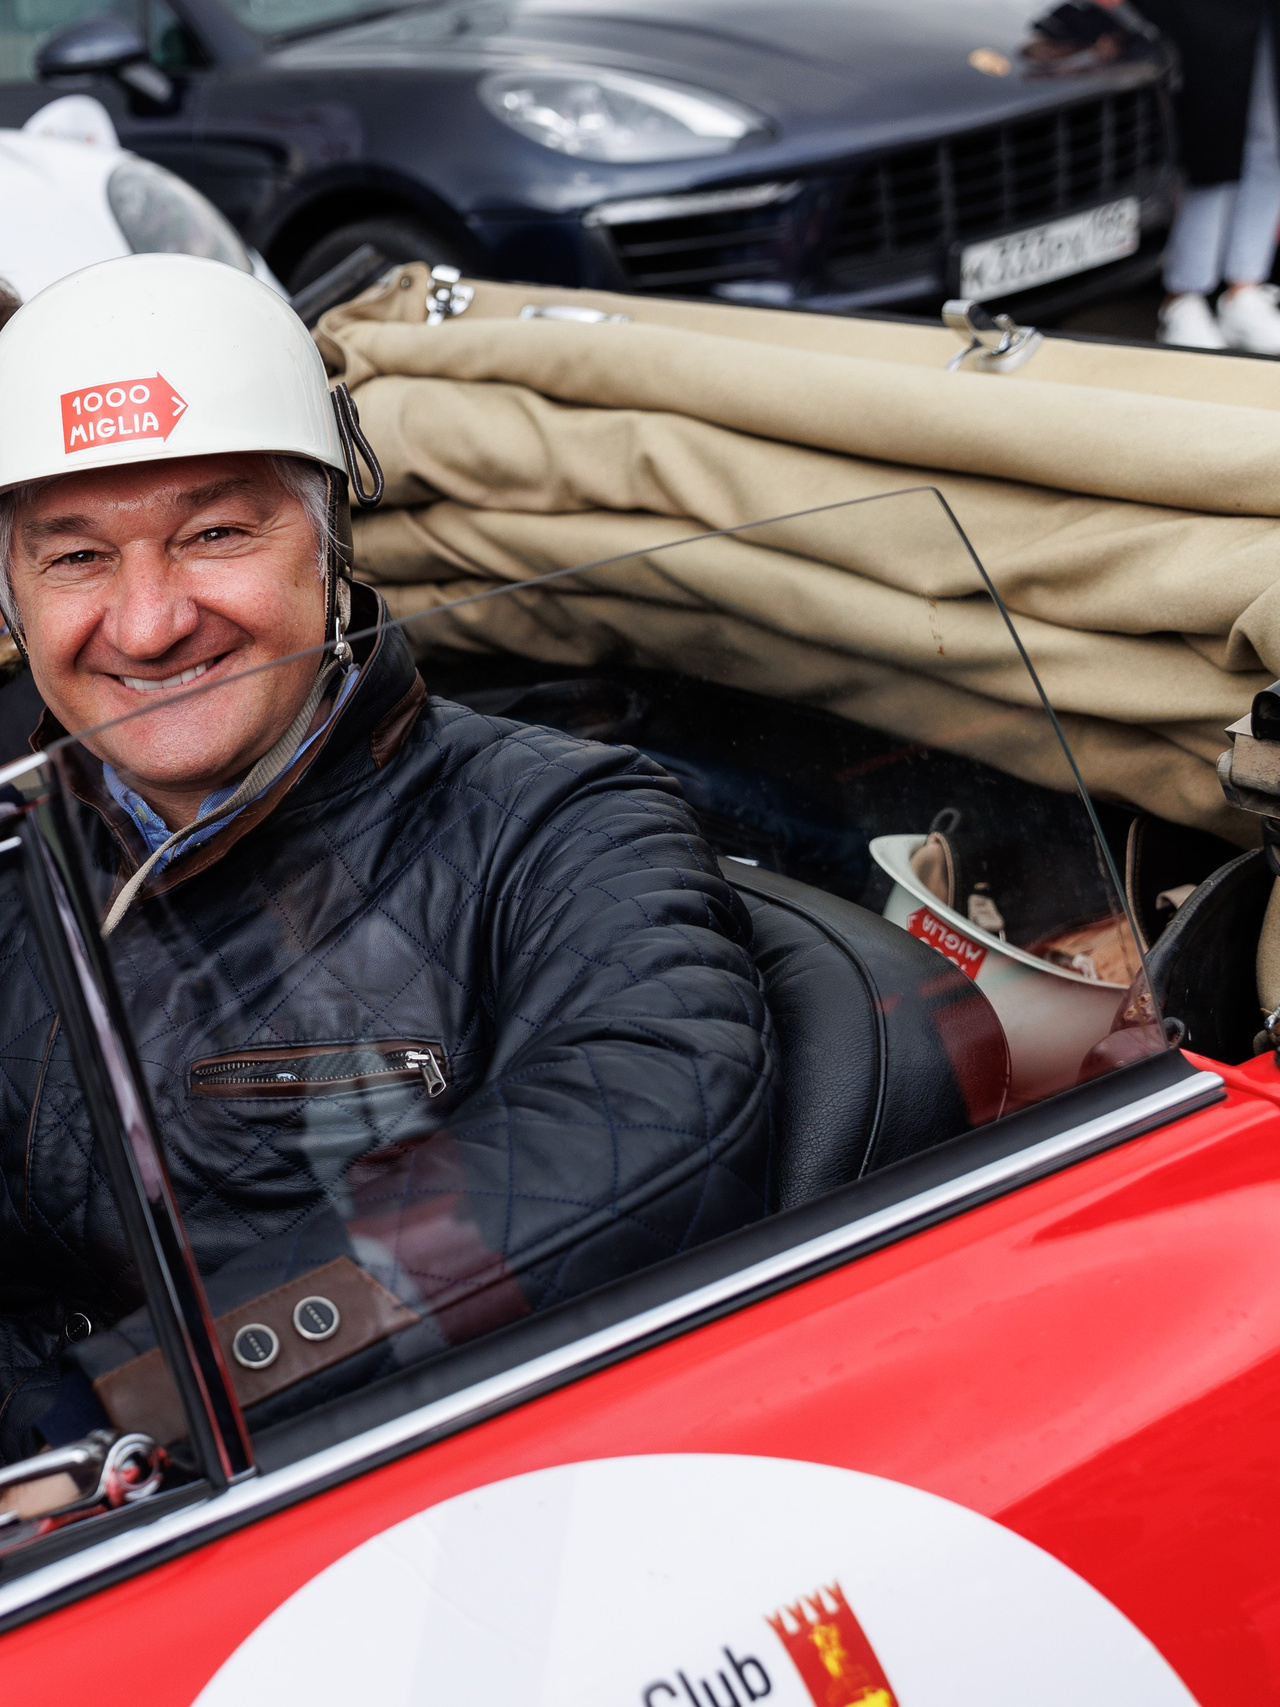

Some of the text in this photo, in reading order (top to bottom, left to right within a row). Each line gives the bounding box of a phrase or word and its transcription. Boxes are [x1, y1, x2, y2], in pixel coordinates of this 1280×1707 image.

[72, 384, 150, 415] 1000
[70, 411, 159, 446] MIGLIA
[922, 914, 982, 962] MIGLIA
